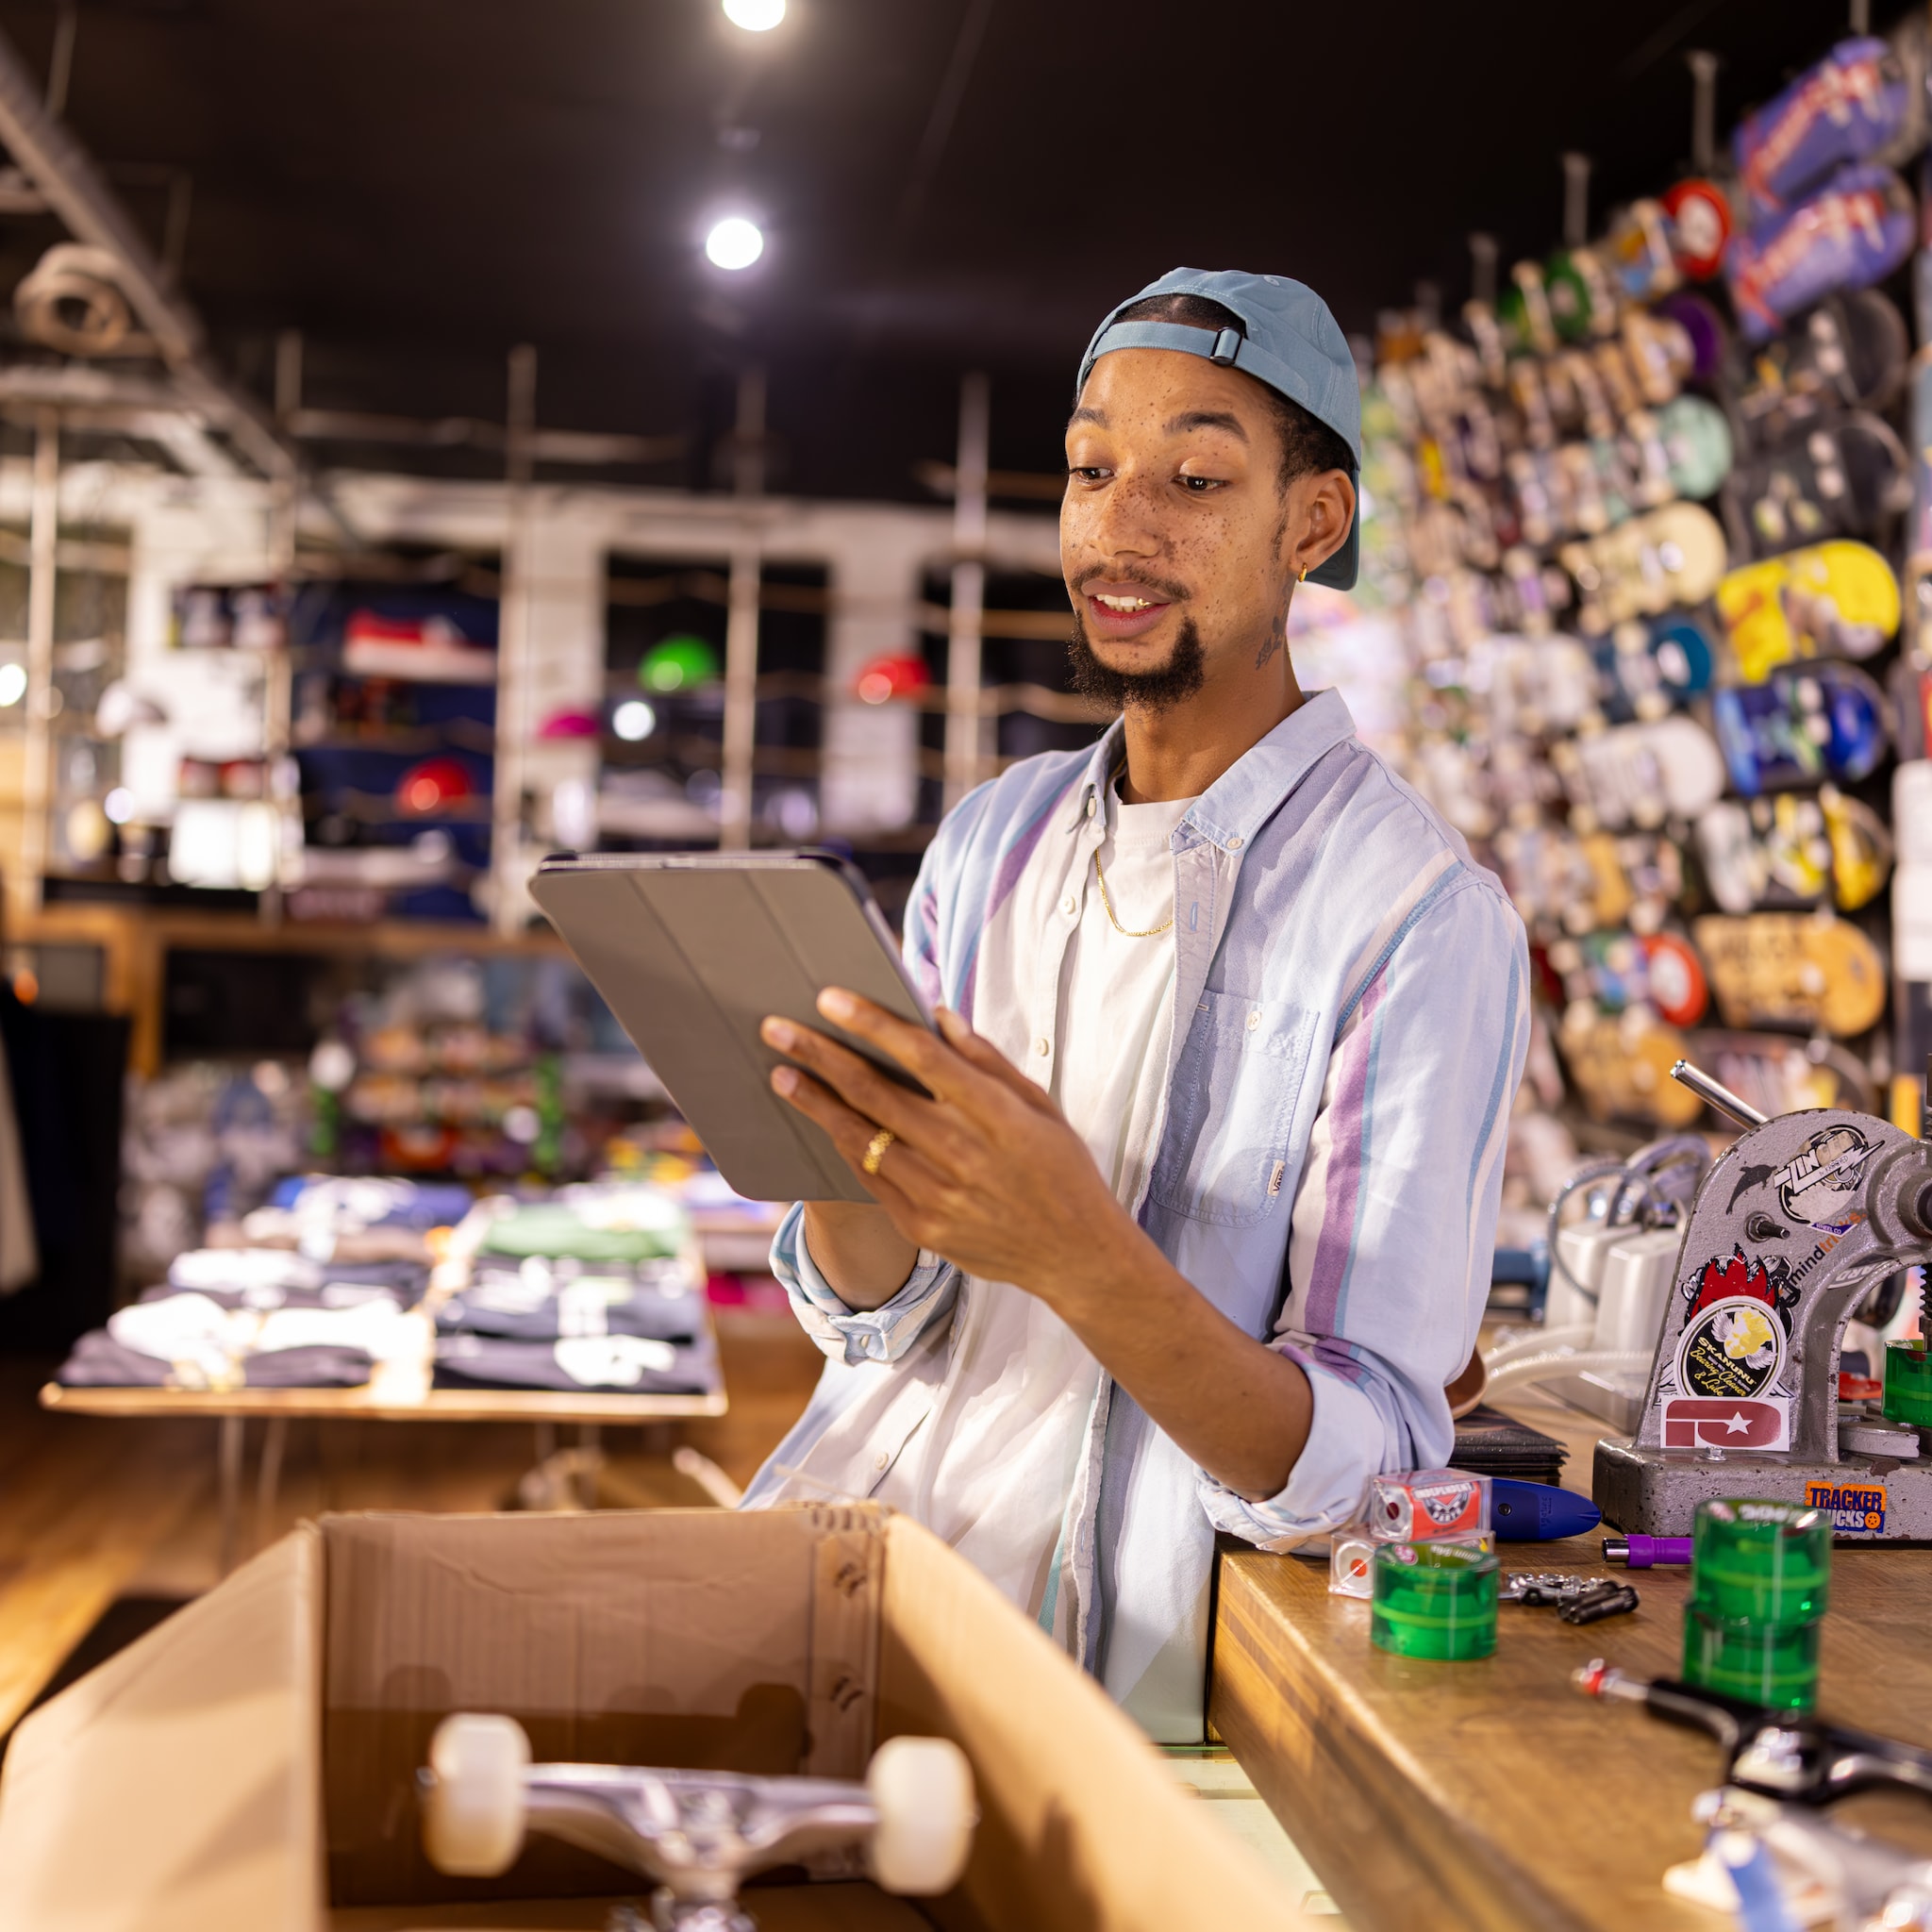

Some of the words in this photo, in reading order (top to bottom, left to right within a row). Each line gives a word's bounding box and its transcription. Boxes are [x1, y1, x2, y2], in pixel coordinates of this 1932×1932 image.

[1790, 1212, 1867, 1286] mindtris.
[1690, 1346, 1720, 1376] Bearing
[1719, 1370, 1747, 1396] Cleaner
[1698, 1337, 1755, 1385] SKANUNU
[1694, 1371, 1707, 1381] &
[1701, 1378, 1724, 1396] Lube
[1414, 1482, 1474, 1499] INDEPENDENT
[1810, 1488, 1882, 1512] TRACKER
[1433, 1507, 1462, 1523] PARTS
[1823, 1508, 1865, 1528] UCKS
